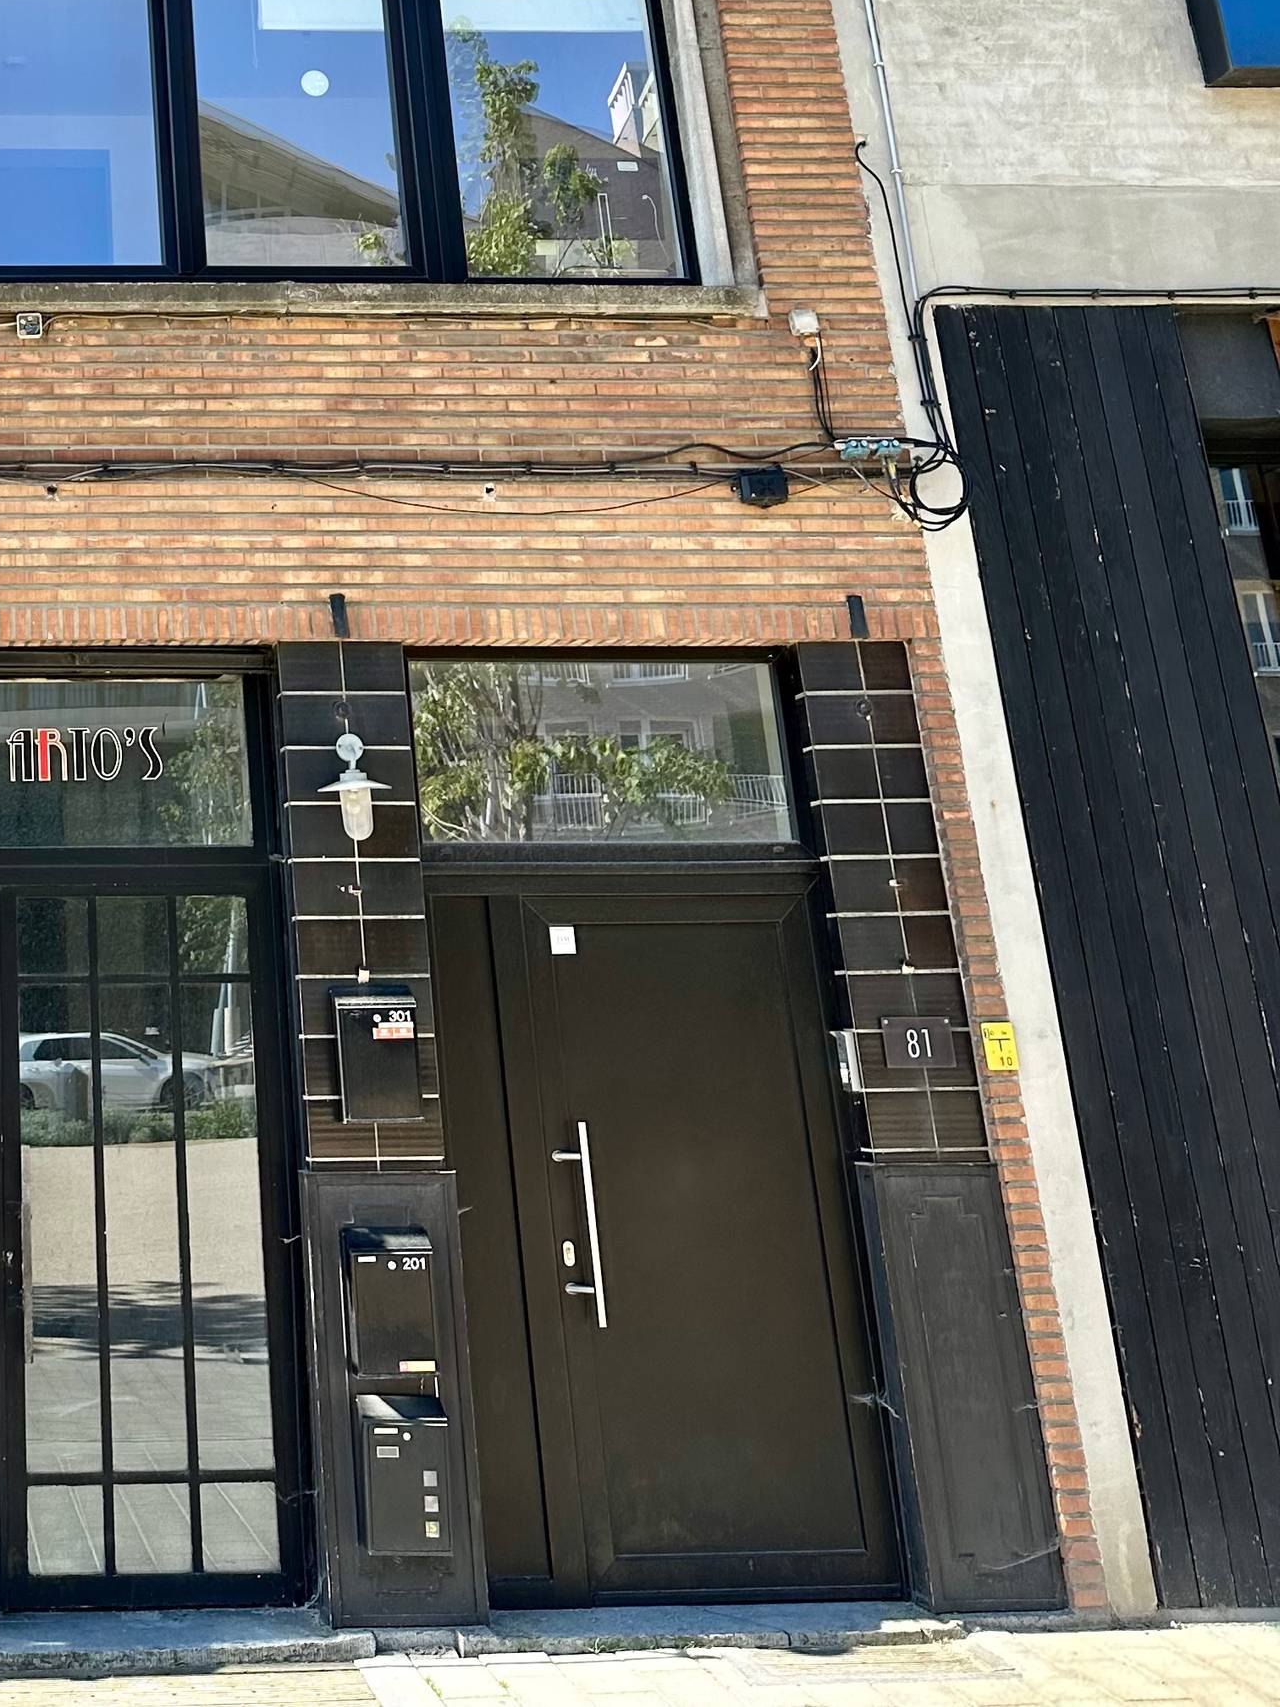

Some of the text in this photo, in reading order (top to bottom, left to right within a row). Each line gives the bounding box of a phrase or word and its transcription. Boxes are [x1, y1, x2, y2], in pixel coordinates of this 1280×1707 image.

[6, 726, 164, 782] ARTO'S
[388, 1009, 412, 1022] 301
[906, 1028, 932, 1059] 81
[1000, 1056, 1013, 1066] 10
[402, 1256, 426, 1270] 201
